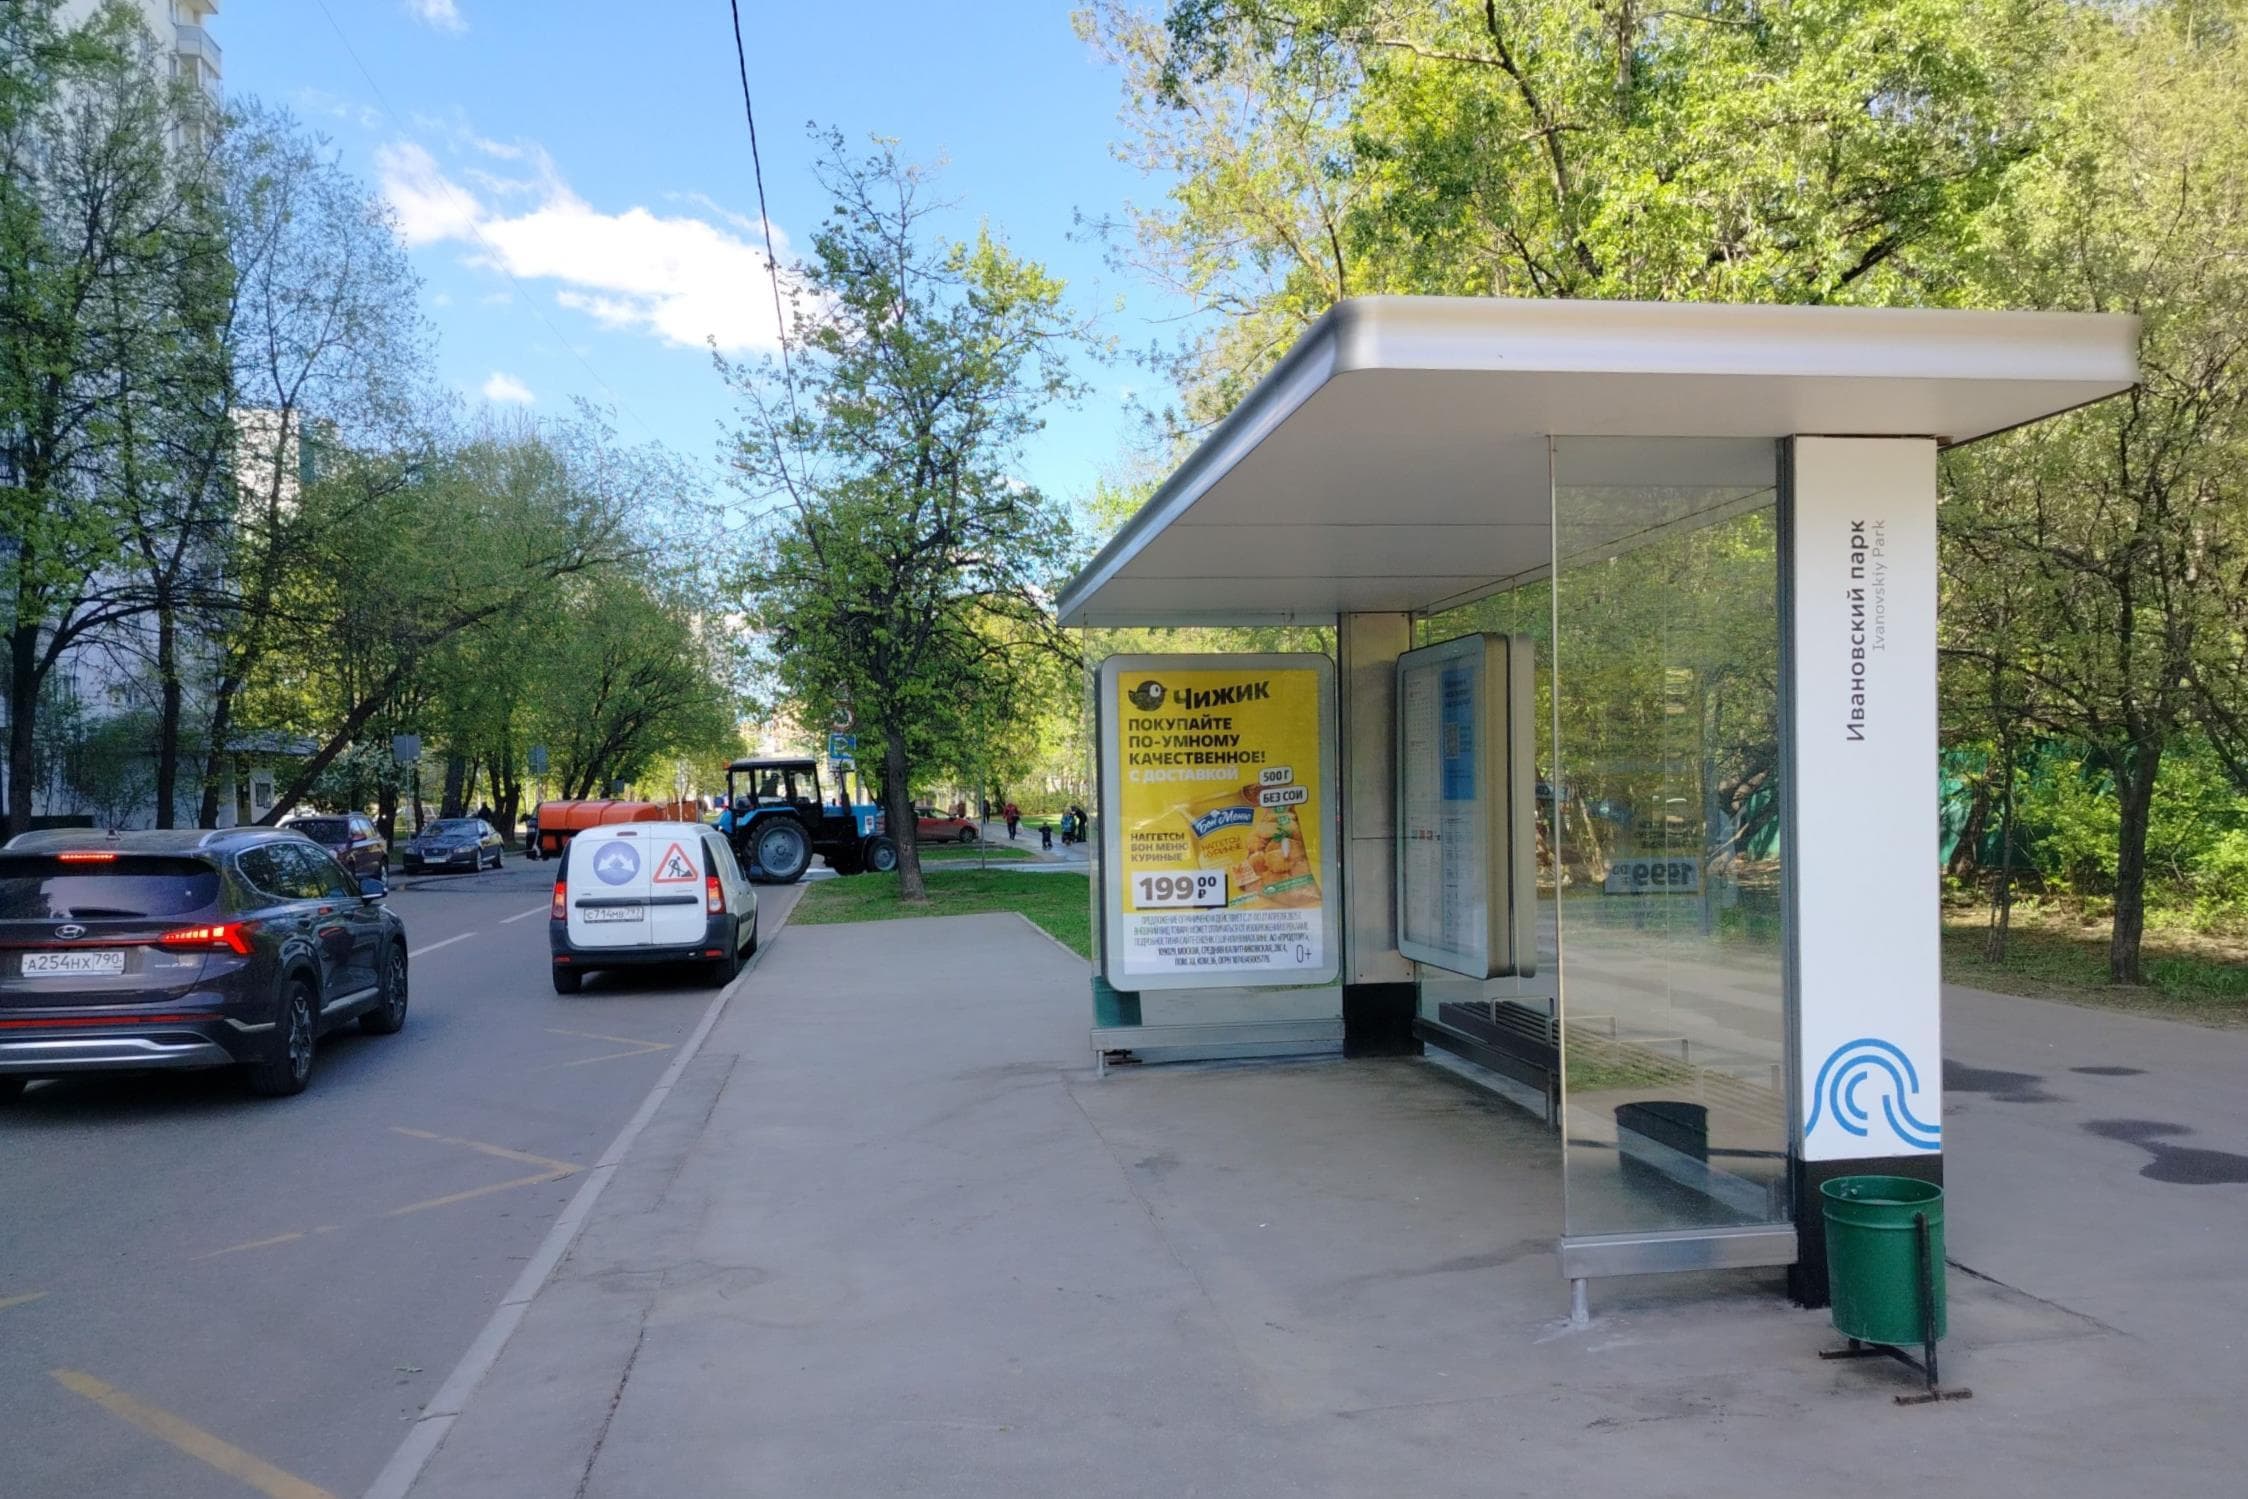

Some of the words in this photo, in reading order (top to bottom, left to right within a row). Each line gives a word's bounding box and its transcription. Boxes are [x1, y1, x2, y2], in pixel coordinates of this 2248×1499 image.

[1872, 519, 1885, 557] Park
[1851, 520, 1869, 579] парк
[1872, 563, 1888, 651] Ivanovskiy
[1847, 588, 1865, 741] Ивановский
[1128, 714, 1232, 731] ПОКУПАЙТЕ
[1128, 734, 1240, 748] ПО-УМНОМУ
[1128, 750, 1266, 765] КАЧЕСТВЕННОЕ!
[1130, 770, 1139, 782] С
[1143, 767, 1239, 783] ДОСТАВКОЙ
[1263, 770, 1282, 782] 500
[1262, 792, 1281, 804] БЕЗ
[1282, 789, 1303, 801] СОИ
[1131, 832, 1185, 841] НАГГЕТСЫ
[1131, 843, 1153, 852] БОН
[1131, 853, 1183, 862] КУРИНЫЕ
[1140, 876, 1194, 901] 199
[1197, 876, 1217, 888] 00
[27, 953, 91, 970] А254НХ
[95, 953, 120, 965] 790
[1296, 944, 1313, 963] 0+
